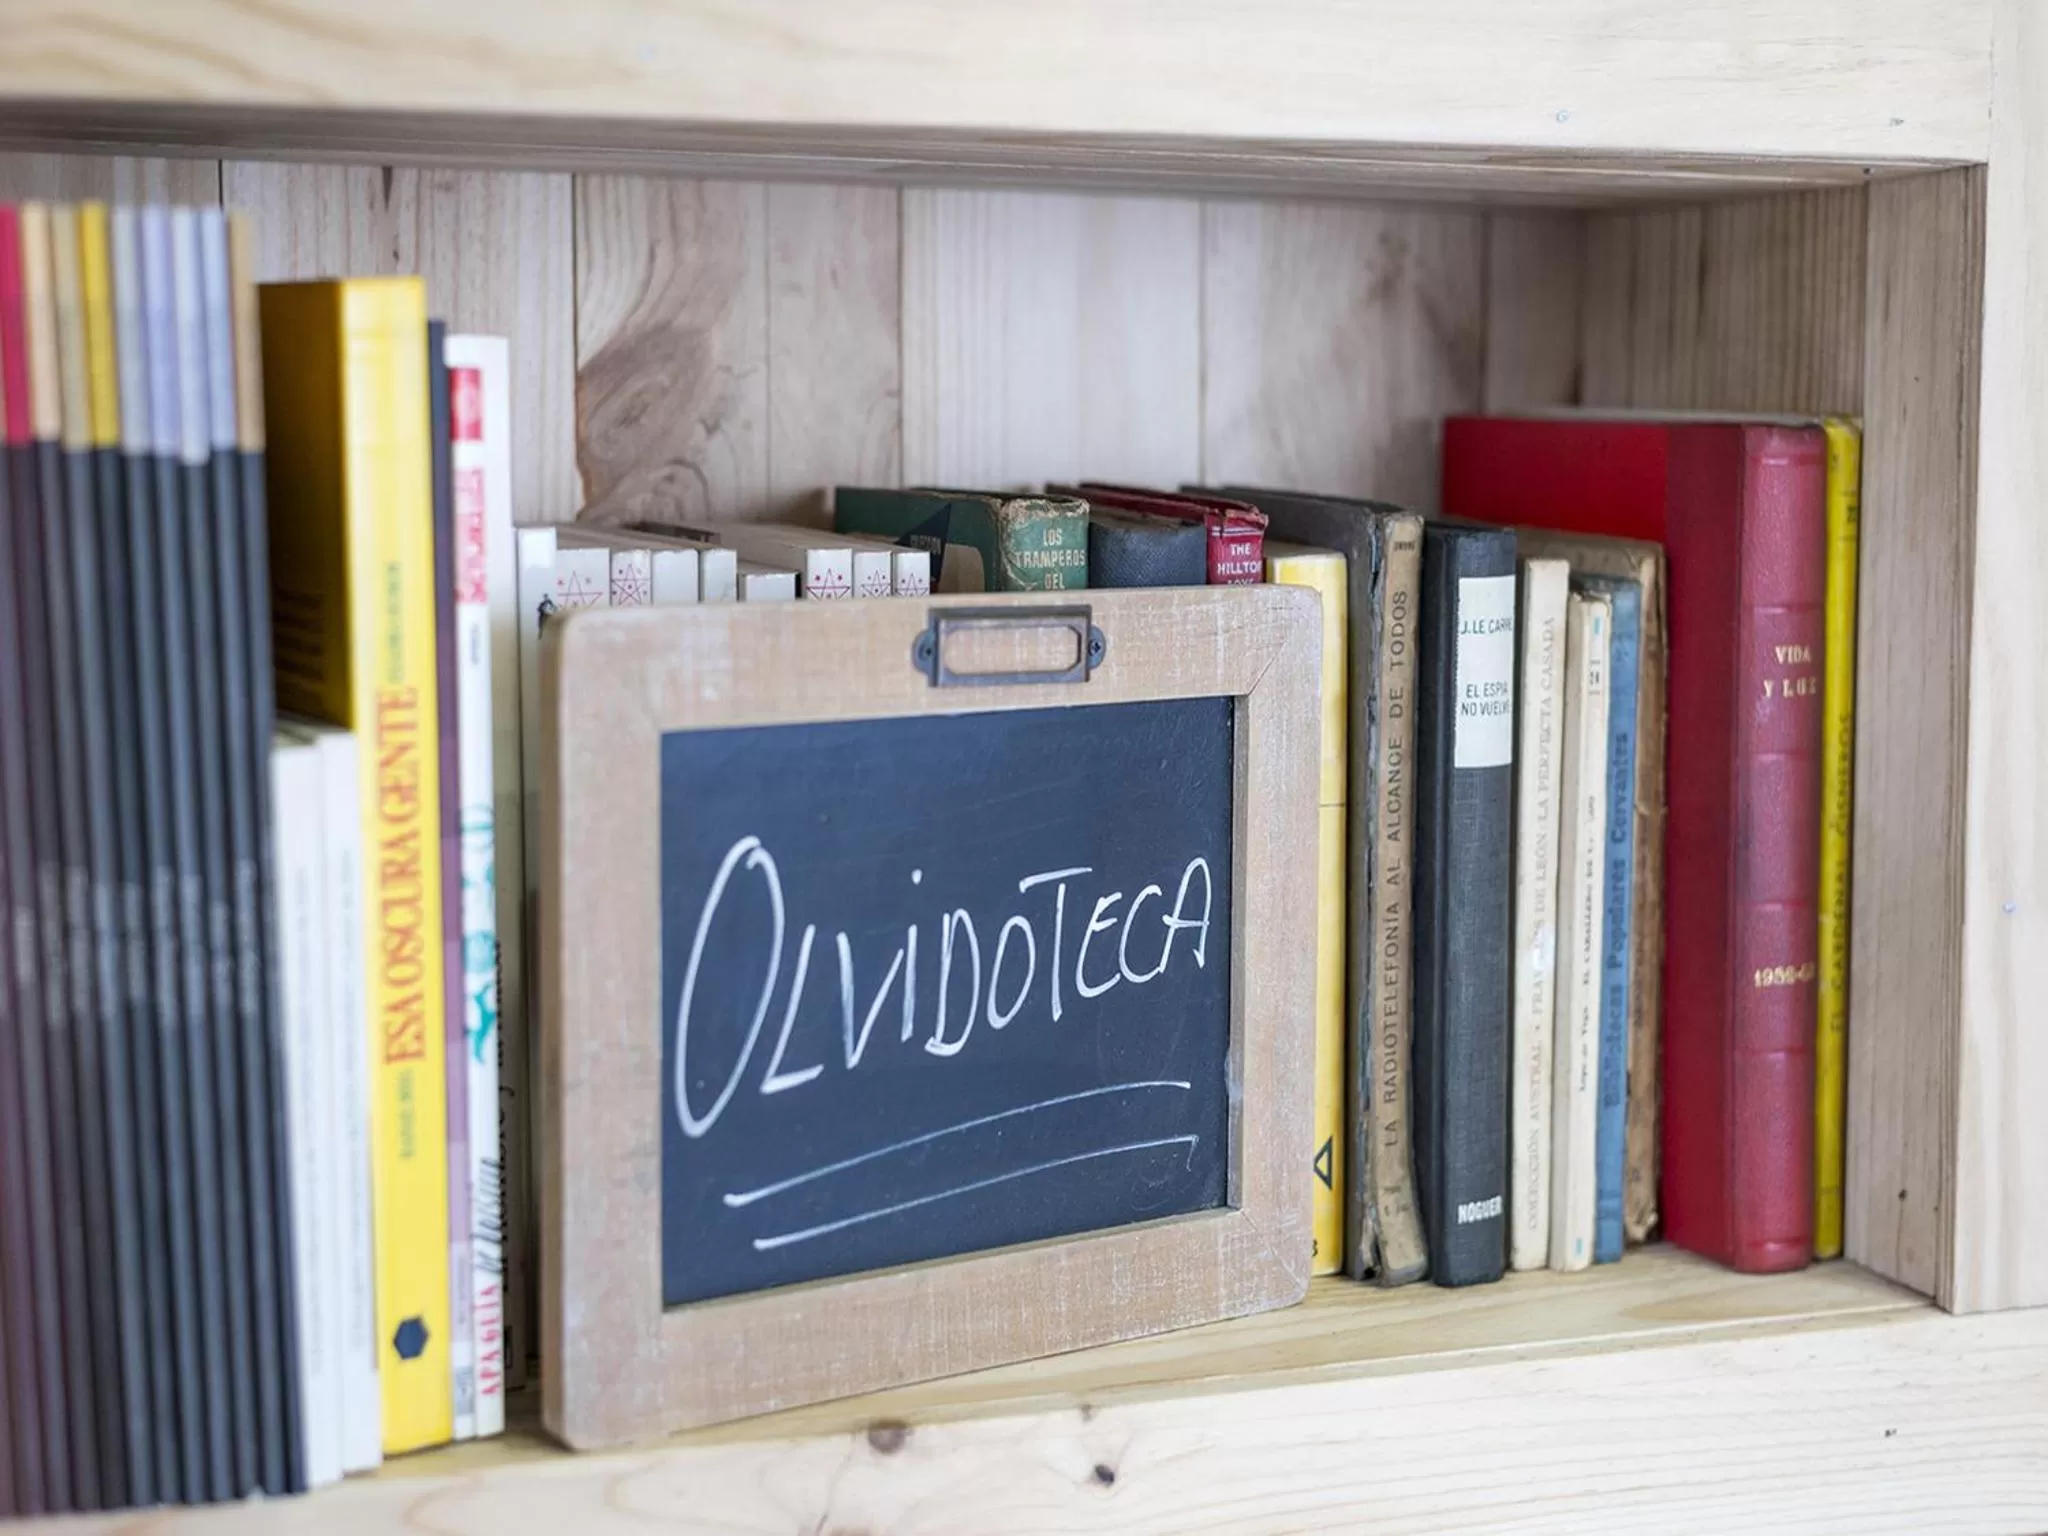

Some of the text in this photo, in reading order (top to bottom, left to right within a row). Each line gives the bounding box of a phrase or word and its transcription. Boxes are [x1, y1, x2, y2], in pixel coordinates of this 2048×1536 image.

[1042, 528, 1063, 547] LOS
[1230, 542, 1251, 556] THE
[1014, 549, 1086, 569] TRAMPEROS
[1044, 572, 1066, 590] DEL
[1541, 617, 1556, 690] CASADA
[1773, 645, 1812, 665] VIDA
[1465, 683, 1480, 699] EL
[1461, 701, 1478, 717] NO
[374, 687, 422, 822] GENTE
[1610, 732, 1629, 845] Cervantes
[1384, 590, 1409, 1146] LA RADIOTELEFONÍA AL ALCANCE DE TODOS
[378, 830, 424, 988] OSCURA
[1604, 860, 1628, 970] Populares
[381, 996, 427, 1066] ESA
[1457, 1195, 1503, 1225] NOGUER
